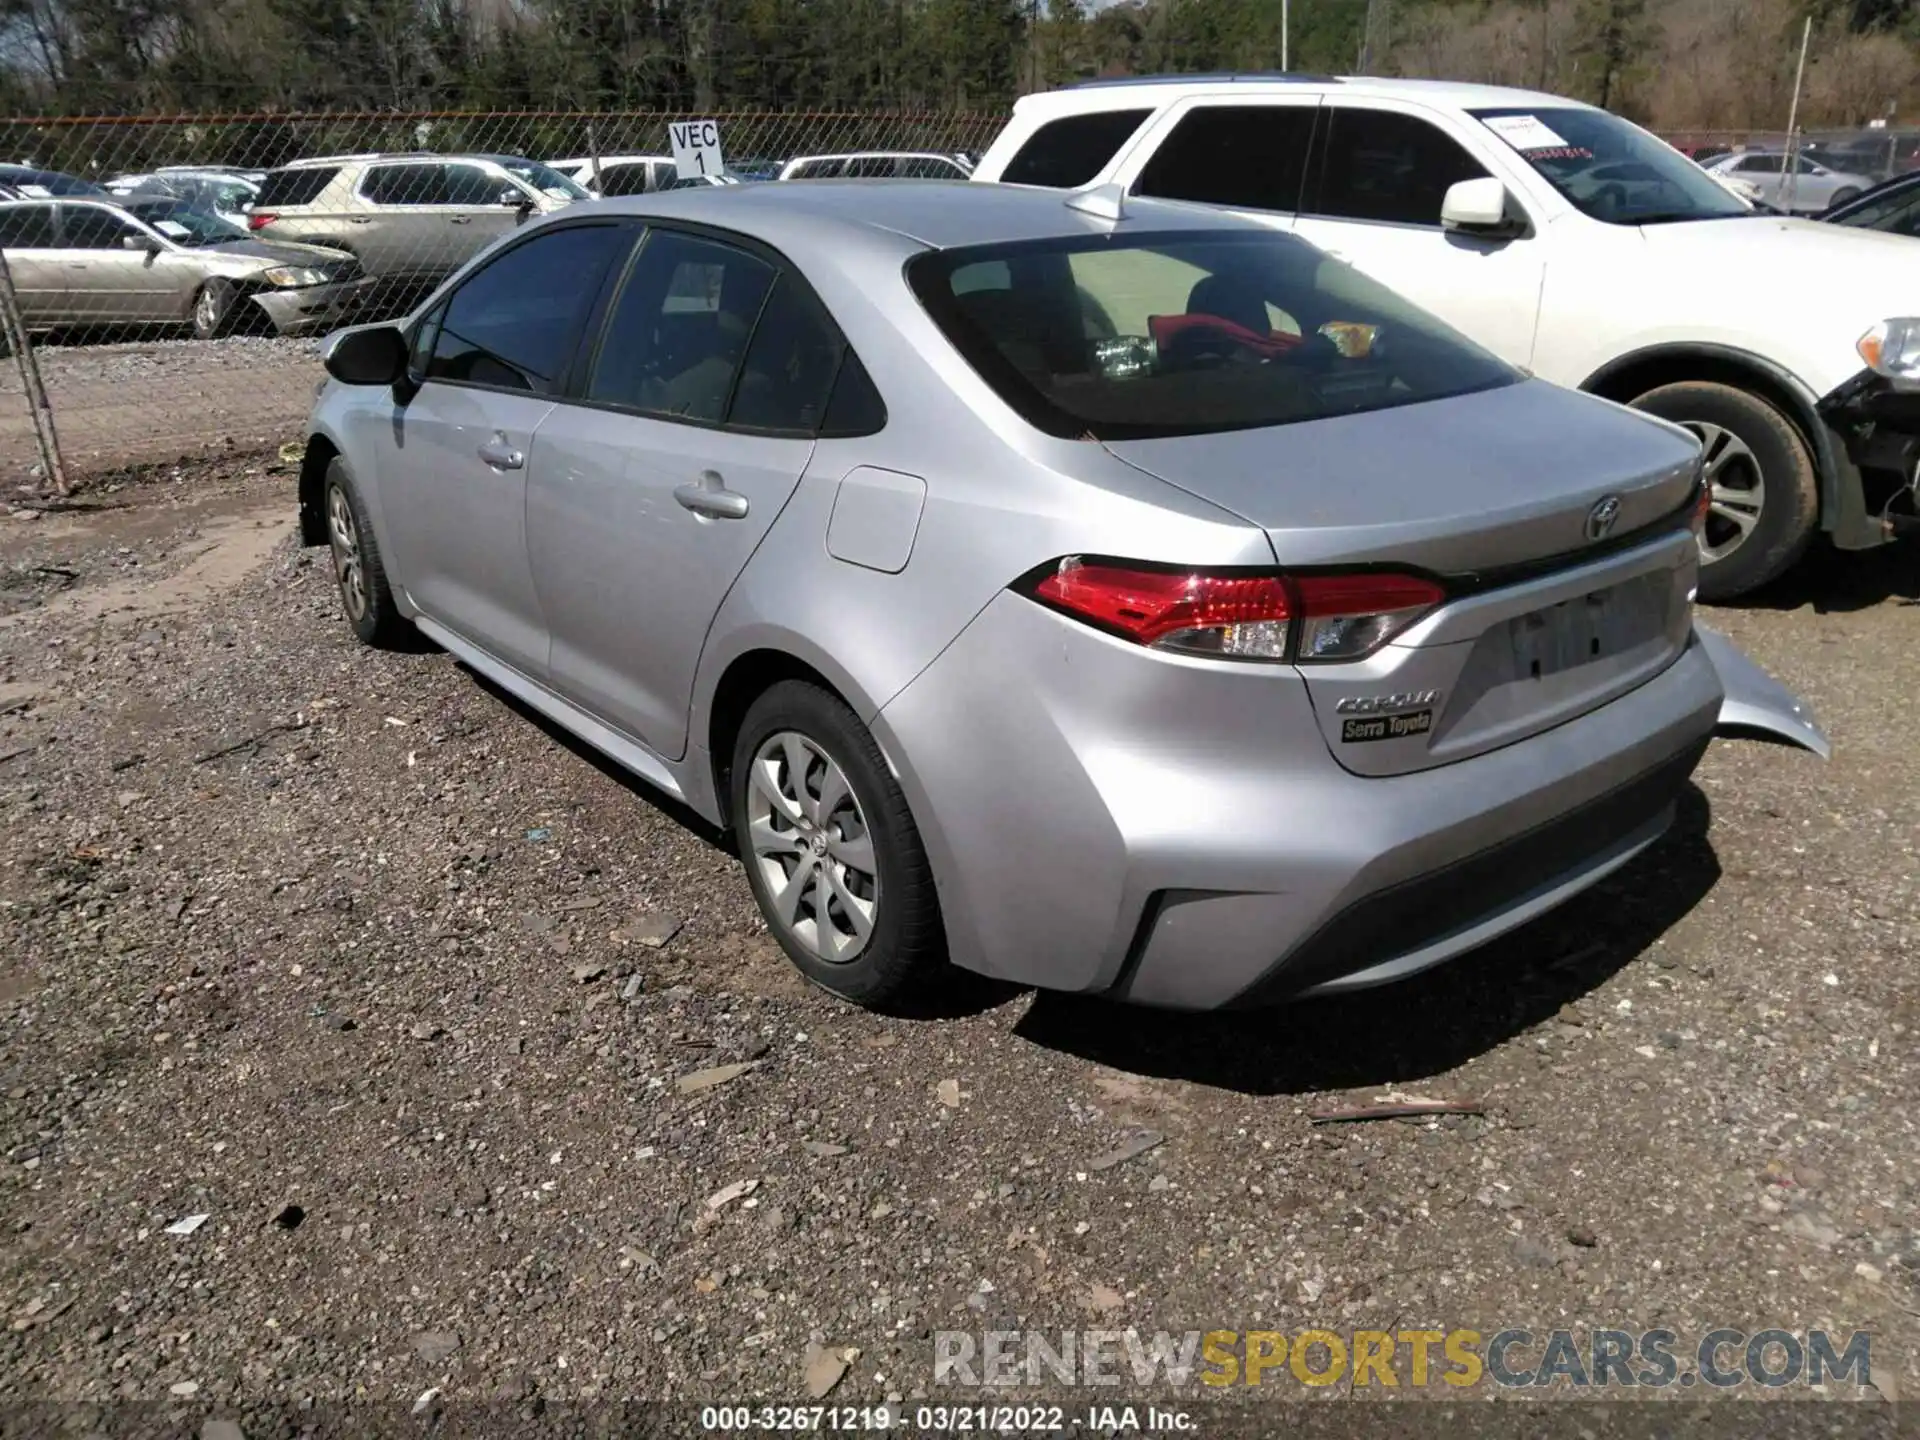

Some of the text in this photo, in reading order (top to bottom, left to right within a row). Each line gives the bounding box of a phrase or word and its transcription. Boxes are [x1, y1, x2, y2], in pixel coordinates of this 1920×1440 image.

[673, 123, 716, 149] VEC
[695, 151, 705, 175] 1
[1345, 713, 1430, 738] Serra Toyota
